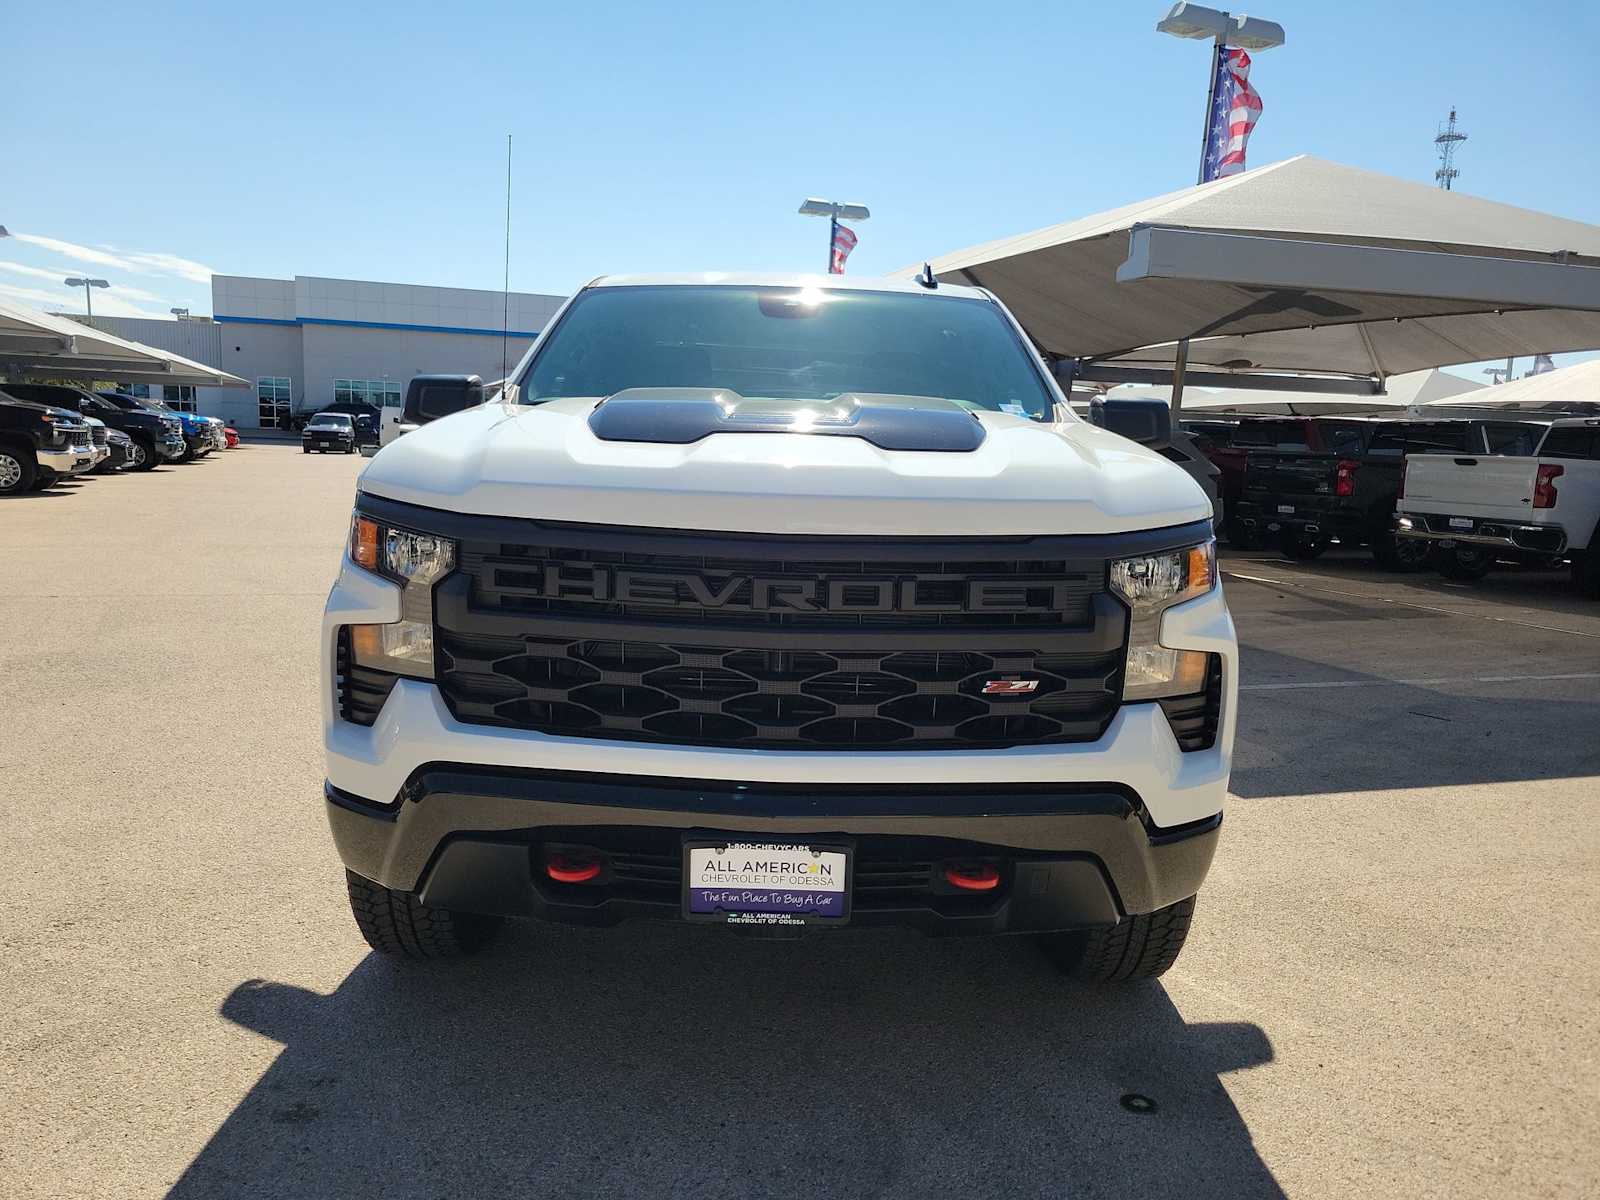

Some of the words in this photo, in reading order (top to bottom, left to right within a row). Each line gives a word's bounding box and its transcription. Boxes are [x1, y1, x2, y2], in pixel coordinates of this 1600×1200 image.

[480, 559, 1087, 612] CHEVROLET
[726, 842, 810, 852] 1-800-CHEVYCARS
[704, 860, 737, 873] ALL
[742, 861, 832, 876] AMERICN
[701, 873, 767, 884] CHEVROLET
[770, 875, 786, 885] OF
[788, 876, 835, 887] ODESSA
[701, 890, 719, 903] The
[720, 891, 740, 903] Fun
[741, 891, 769, 904] Place
[769, 892, 782, 904] To
[783, 893, 804, 908] Buy
[804, 894, 814, 905] A
[815, 894, 833, 906] Car
